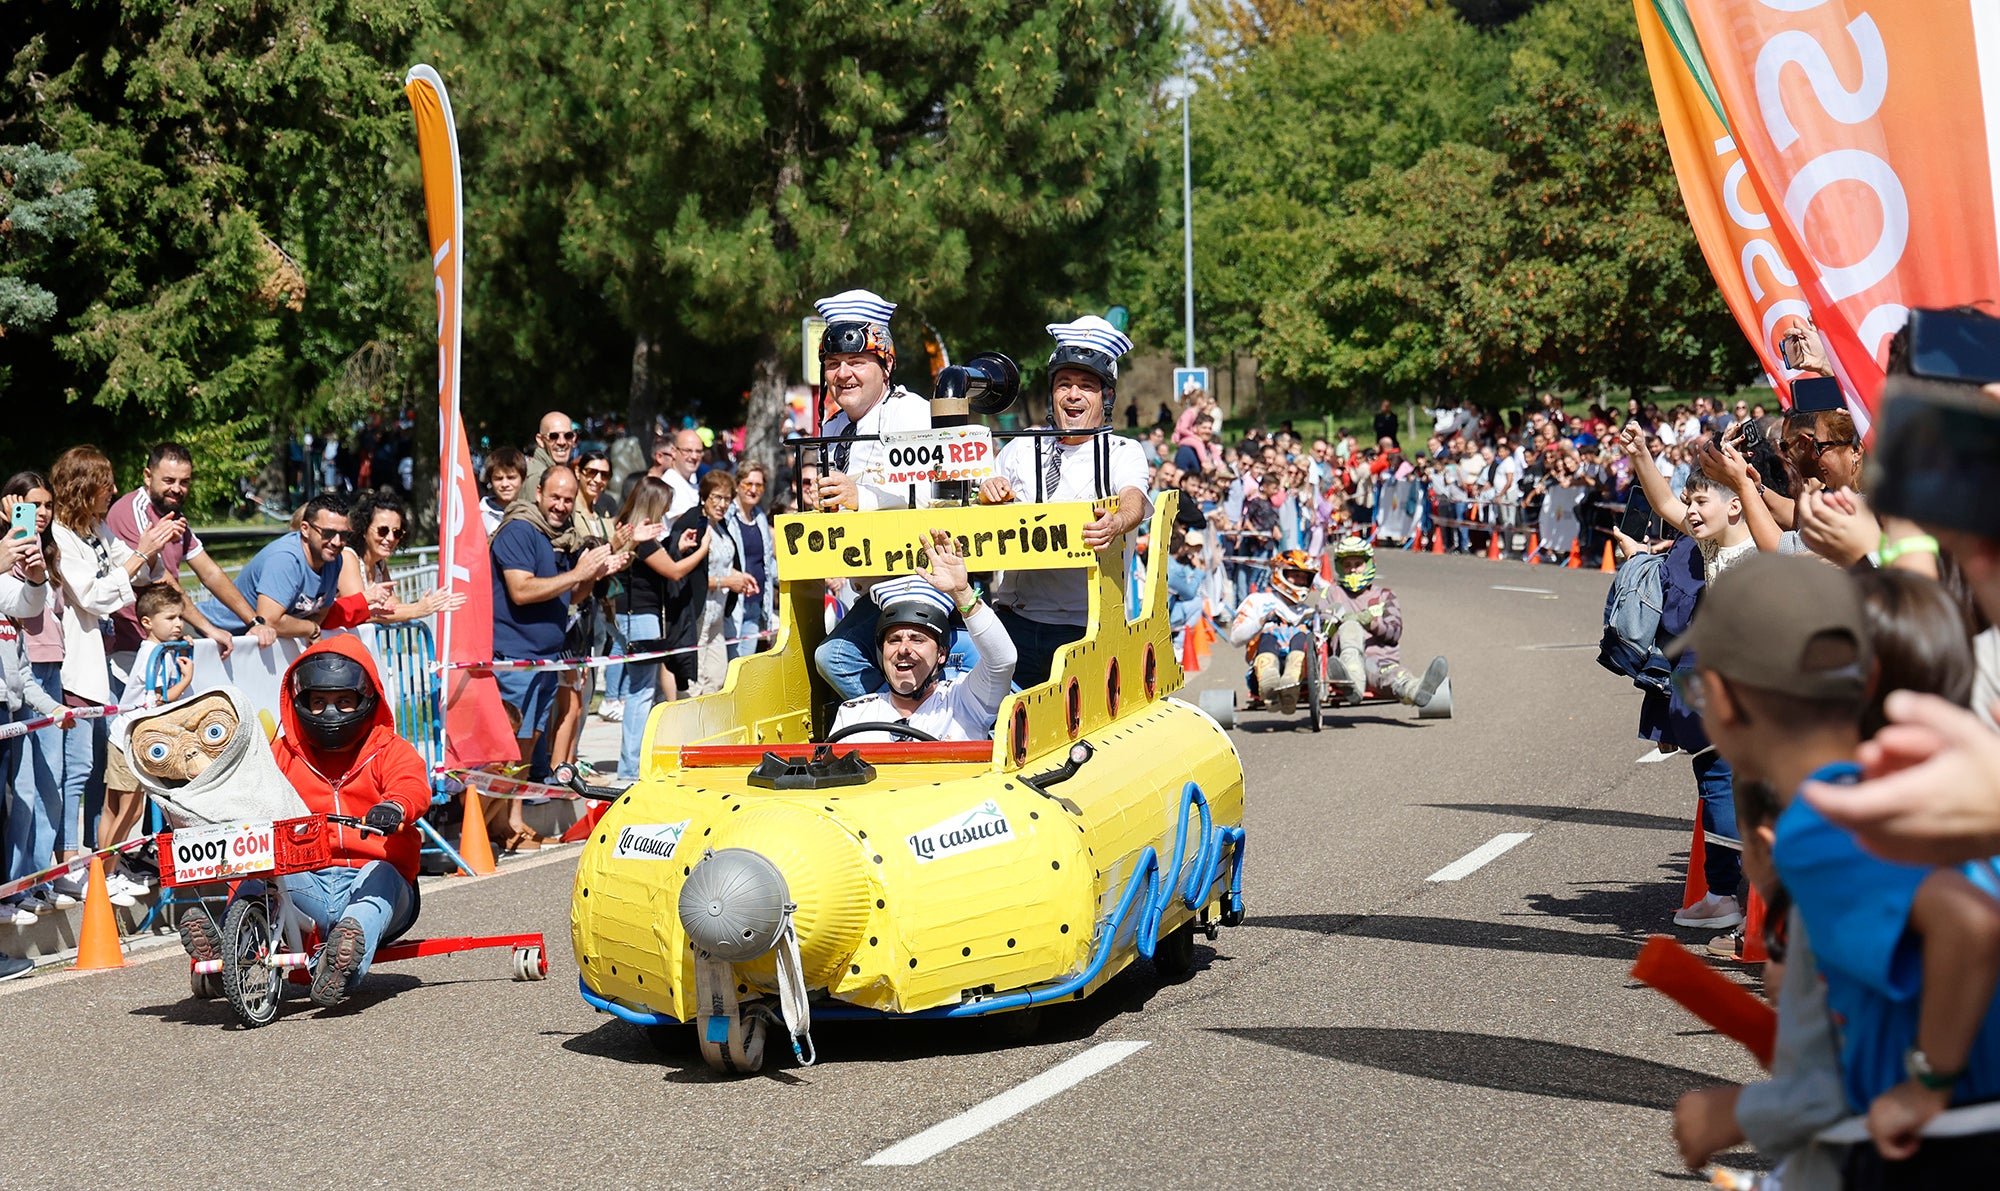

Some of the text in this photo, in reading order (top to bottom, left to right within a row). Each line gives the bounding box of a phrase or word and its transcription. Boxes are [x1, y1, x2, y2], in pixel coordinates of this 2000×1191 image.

[889, 442, 988, 467] 0004 REP
[784, 522, 845, 555] Por
[842, 538, 872, 567] el
[178, 838, 227, 863] 0007
[232, 832, 270, 857] GÓN
[618, 826, 675, 859] La casuca
[909, 817, 1009, 858] La casuca
